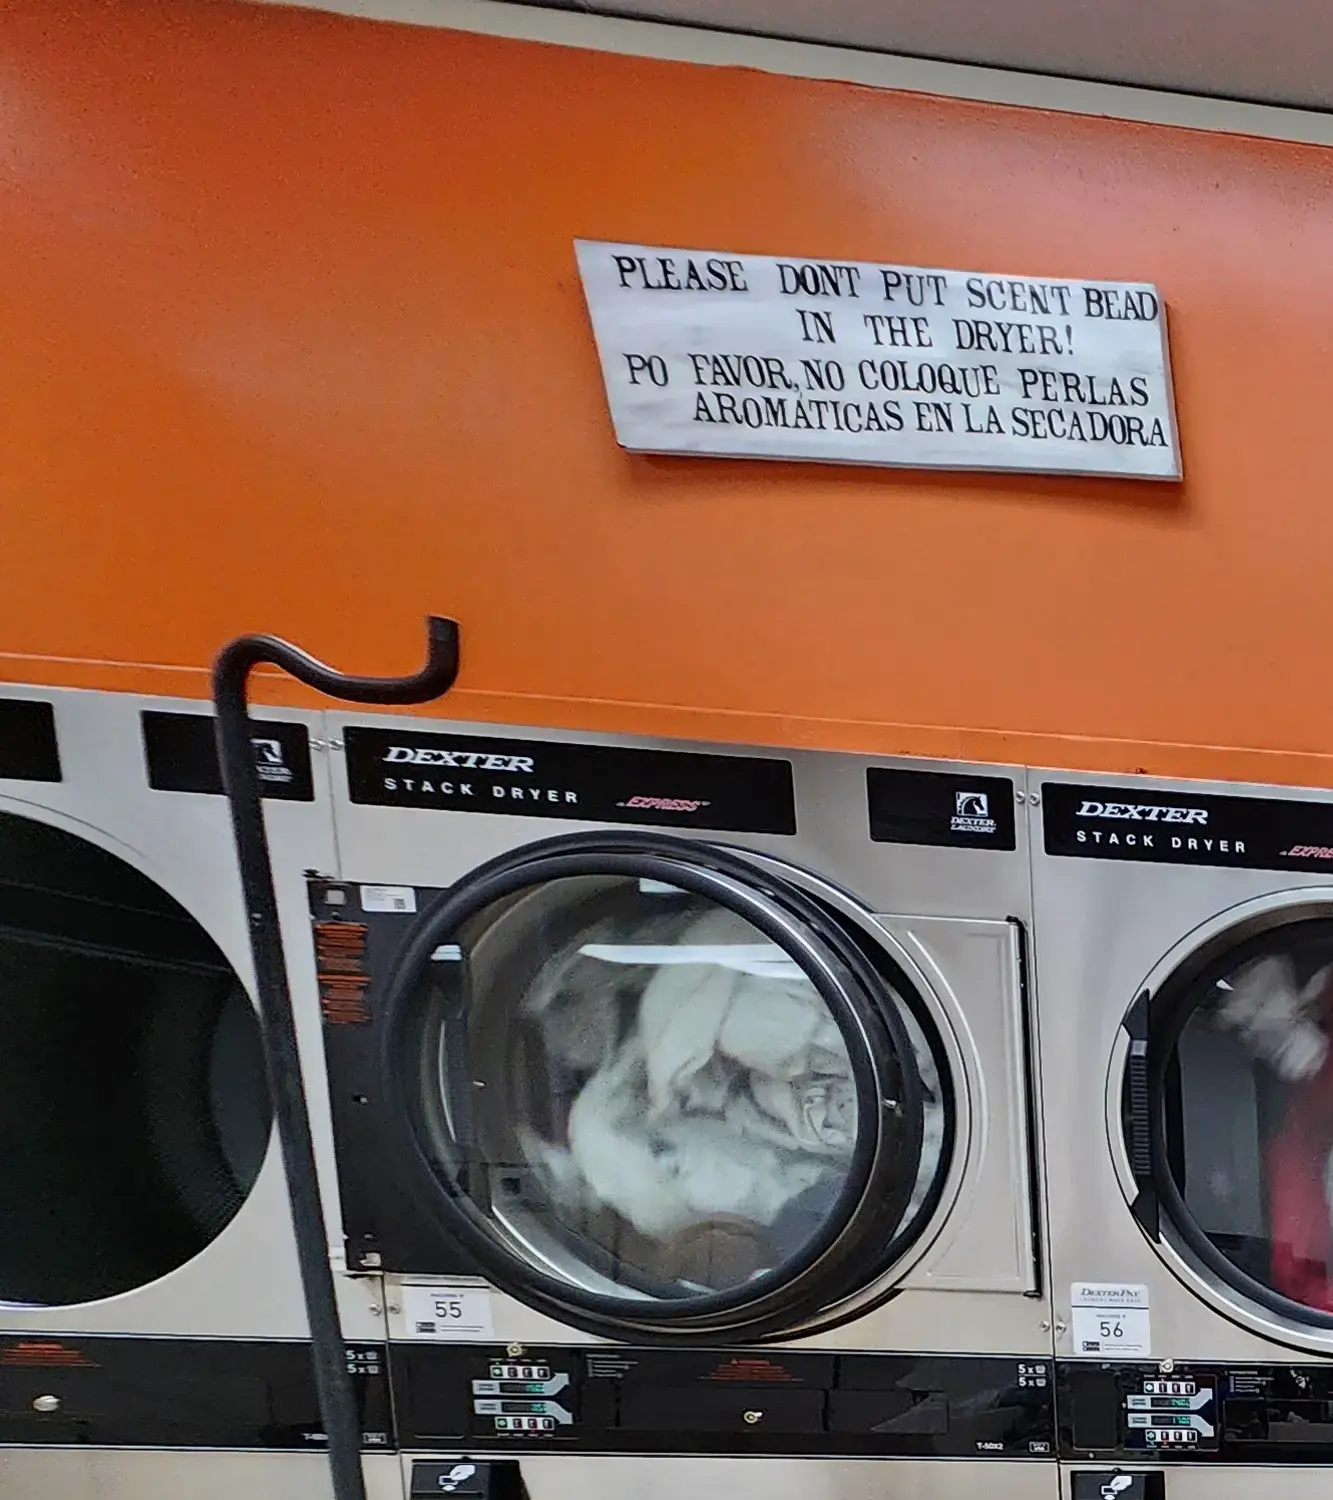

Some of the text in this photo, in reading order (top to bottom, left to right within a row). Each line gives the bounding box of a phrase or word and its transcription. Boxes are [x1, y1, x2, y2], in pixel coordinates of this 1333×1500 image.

[612, 255, 1157, 321] PLEASE DONT PUT SCENT BEAD
[796, 309, 1073, 354] IN THE DRYER!
[622, 353, 668, 386] PO
[859, 359, 1000, 397] COLOQUE
[1018, 368, 1149, 406] PERLAS
[913, 401, 953, 432] EN
[961, 403, 1005, 434] LA
[1012, 407, 1168, 447] SECADORA
[382, 747, 534, 772] DEXTER
[385, 777, 578, 803] STACK DRYER
[1076, 802, 1208, 826] DEXTER
[1076, 830, 1246, 854] STACK DRYER
[435, 1301, 462, 1319] 55
[1100, 1322, 1123, 1337] 56
